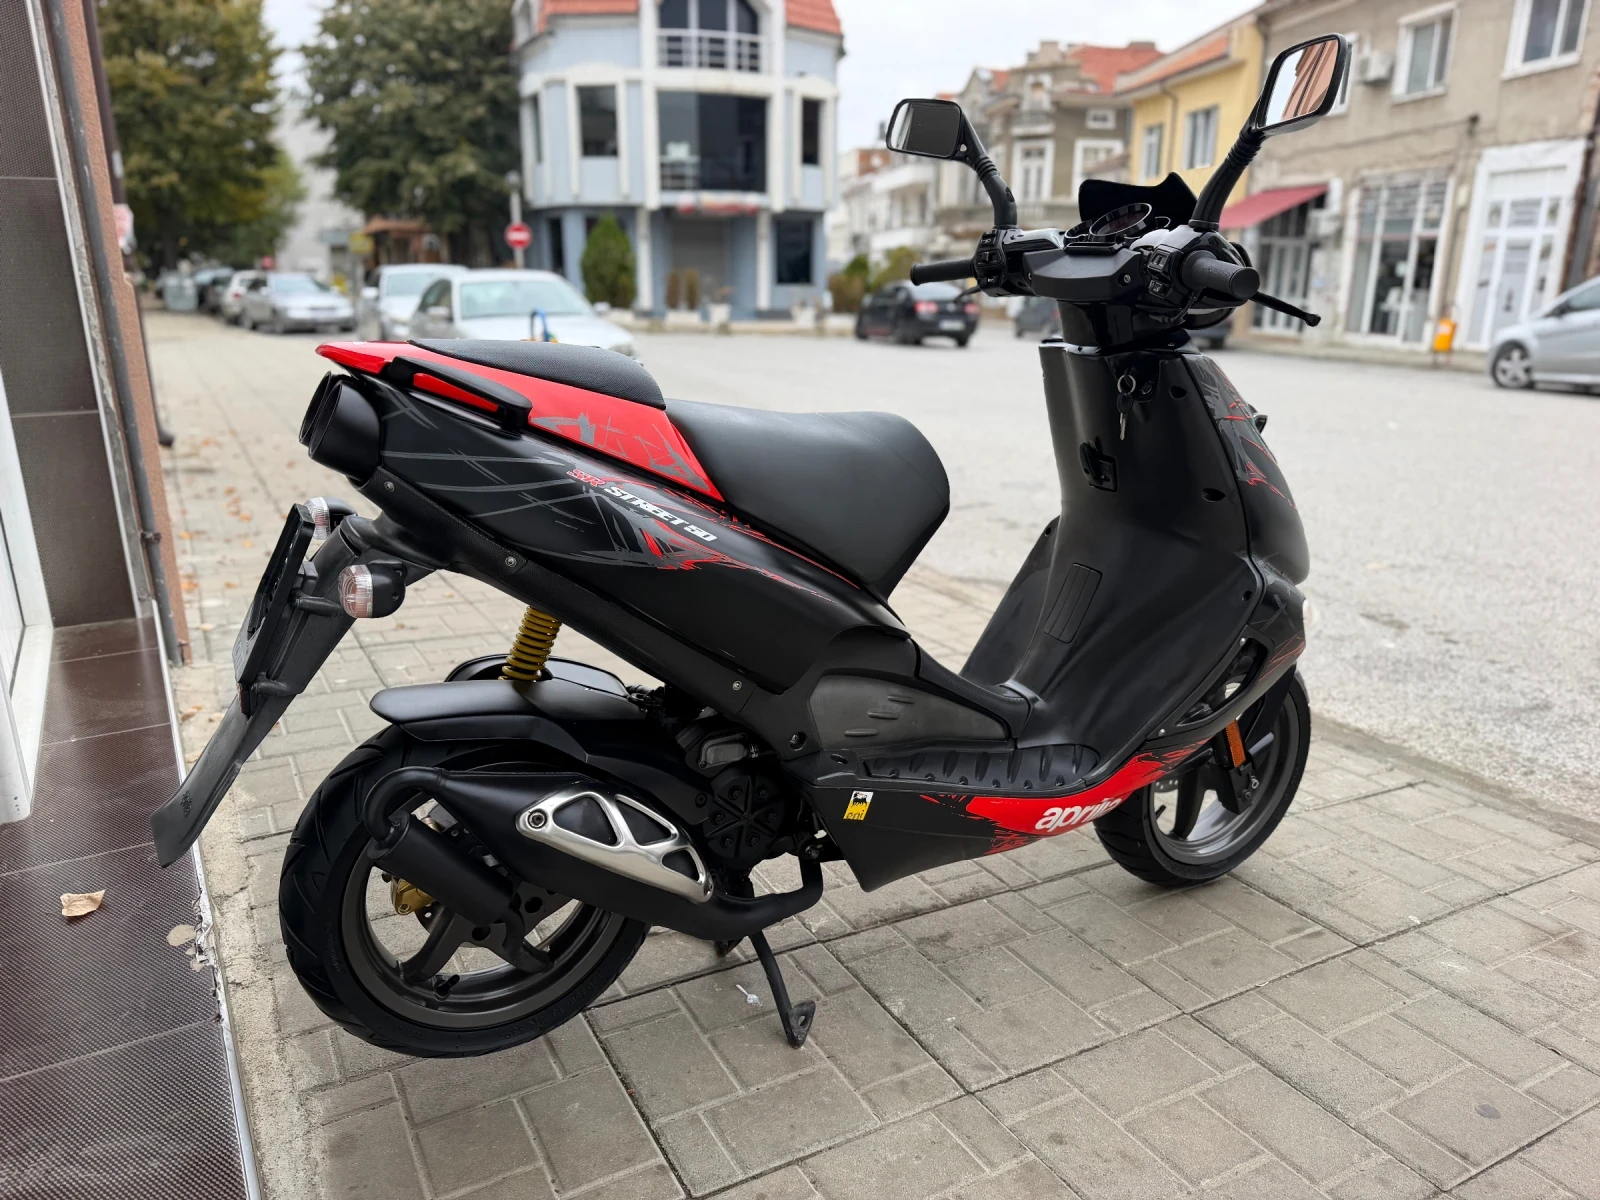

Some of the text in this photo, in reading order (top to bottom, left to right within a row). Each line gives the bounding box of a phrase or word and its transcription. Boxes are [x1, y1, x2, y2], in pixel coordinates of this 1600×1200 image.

[566, 469, 717, 542] SR STREET 50
[846, 809, 864, 820] eni
